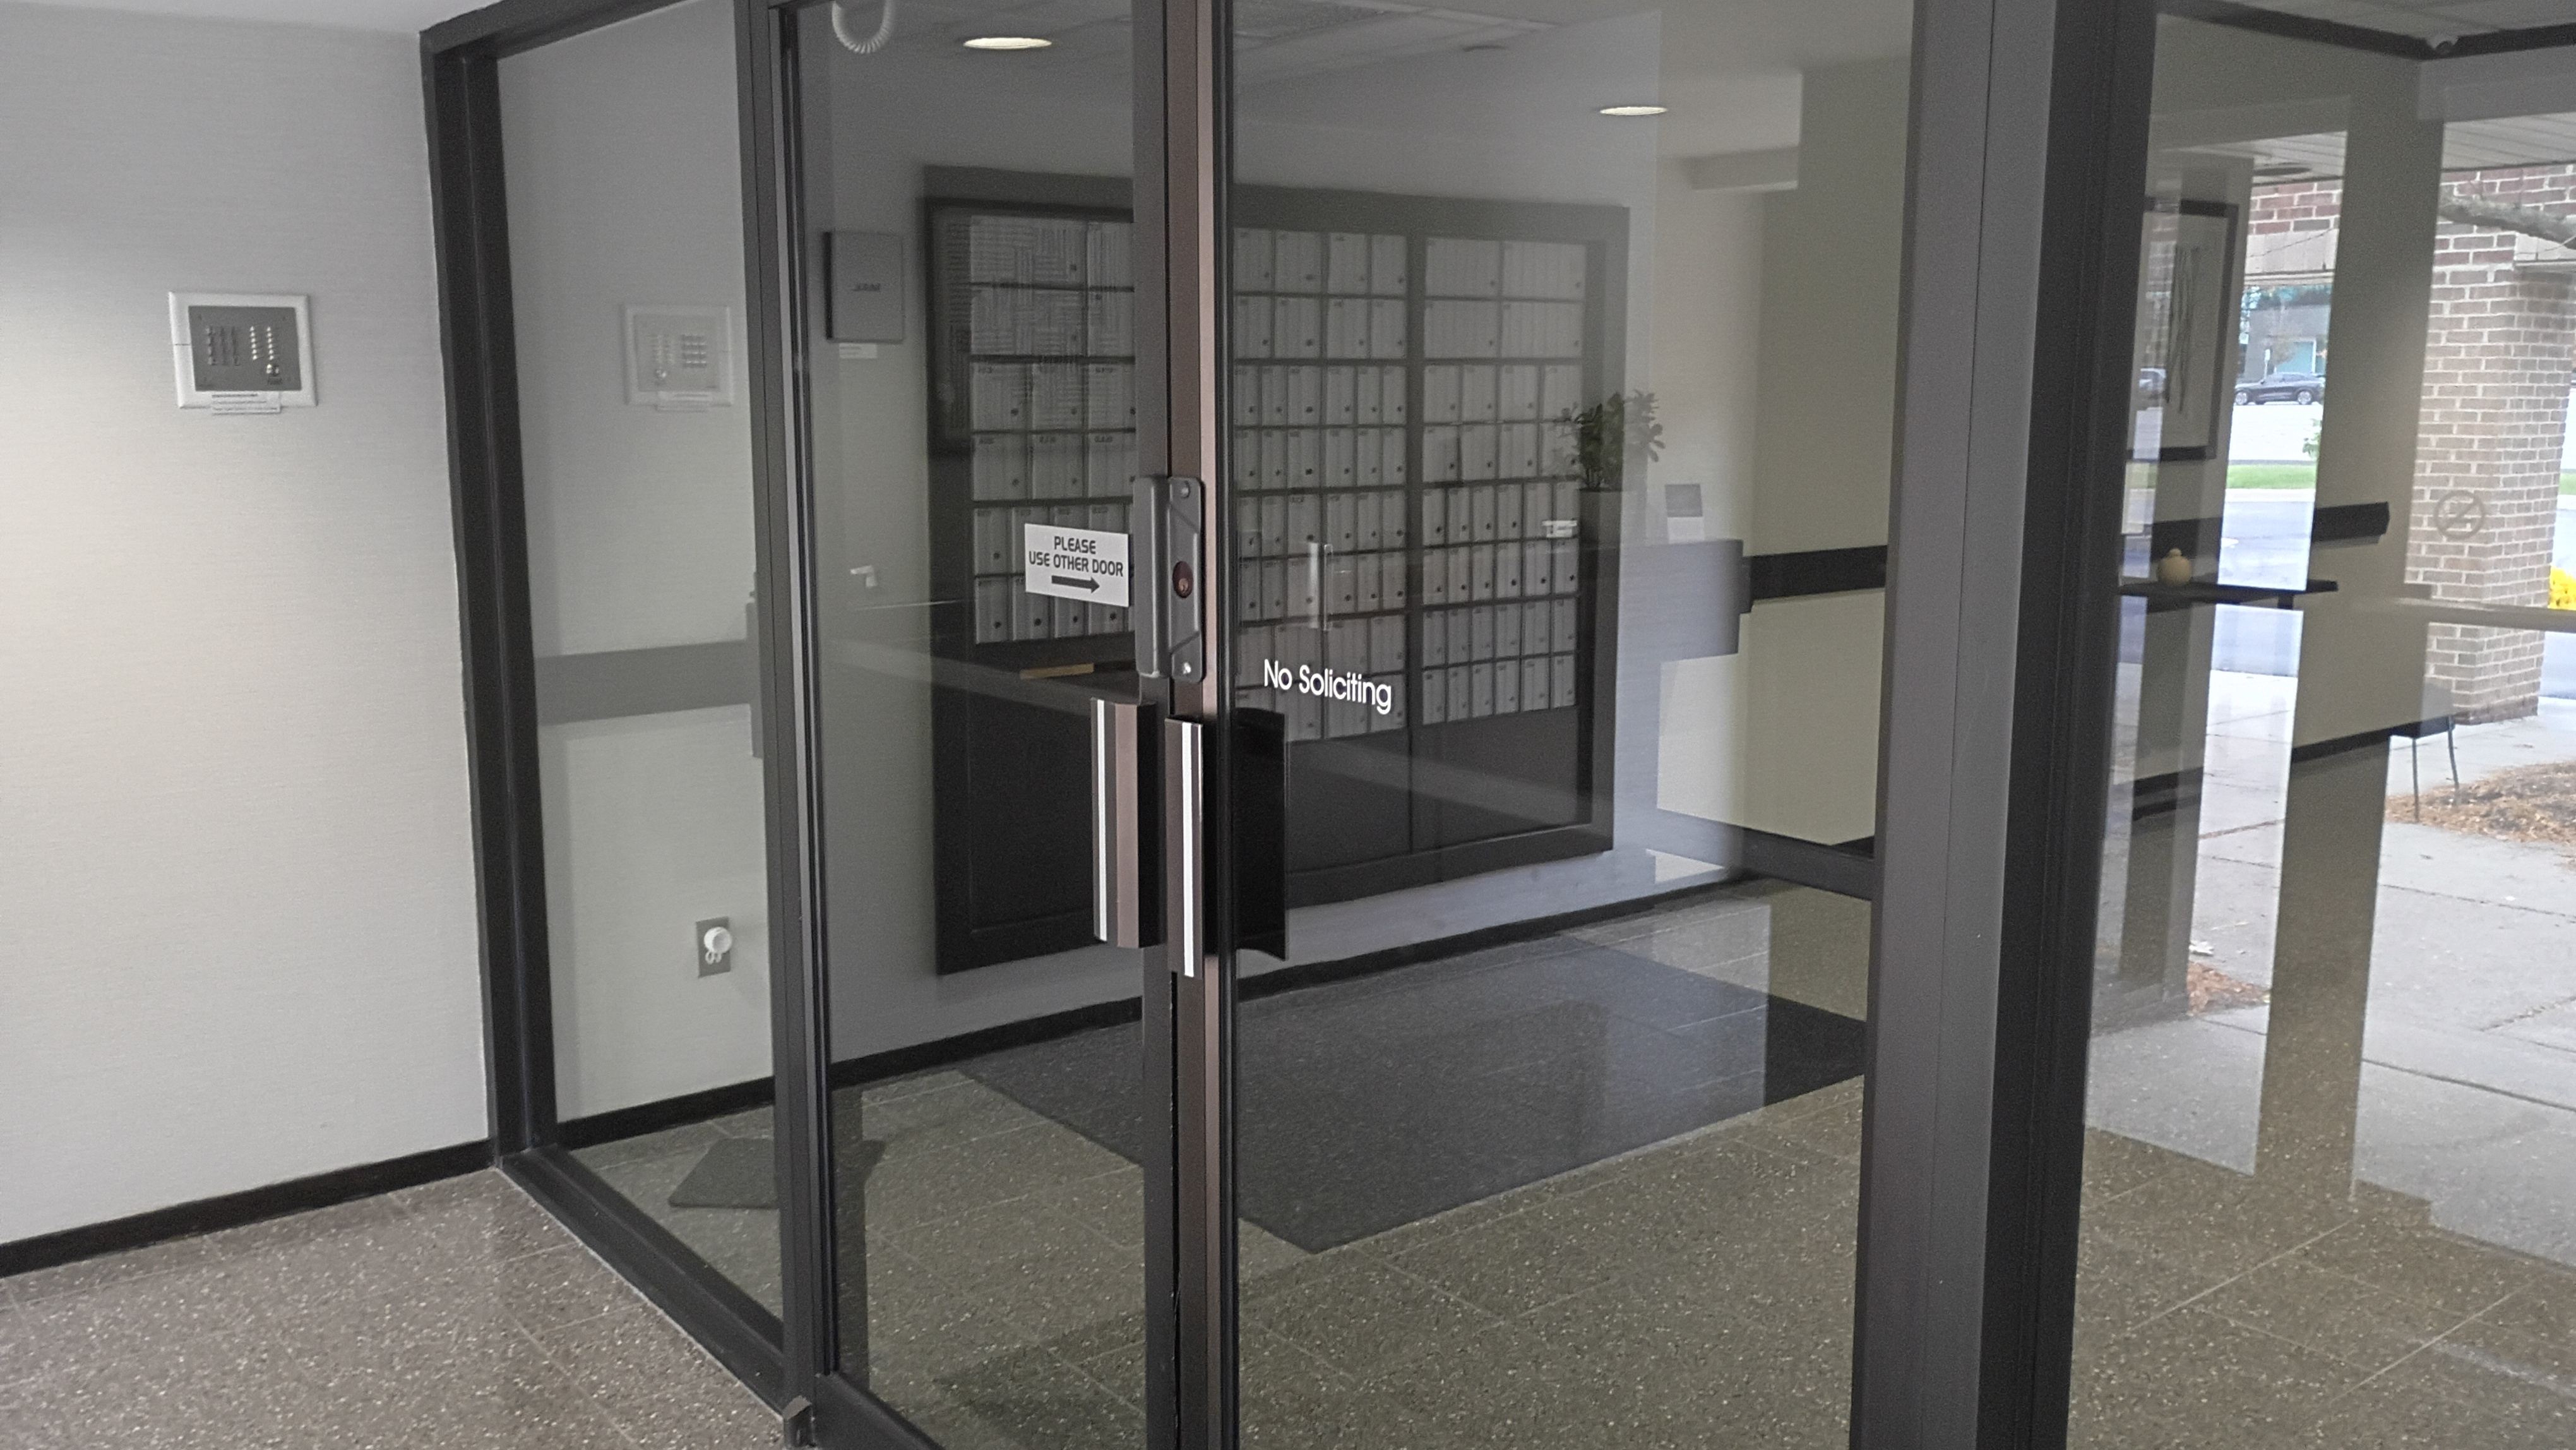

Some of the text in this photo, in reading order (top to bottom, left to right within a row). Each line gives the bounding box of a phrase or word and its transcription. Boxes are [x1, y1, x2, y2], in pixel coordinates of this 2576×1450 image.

[1054, 536, 1096, 554] PLEASE
[1029, 551, 1124, 577] USE OTHER DOOR
[1264, 659, 1392, 714] No Soliciting
